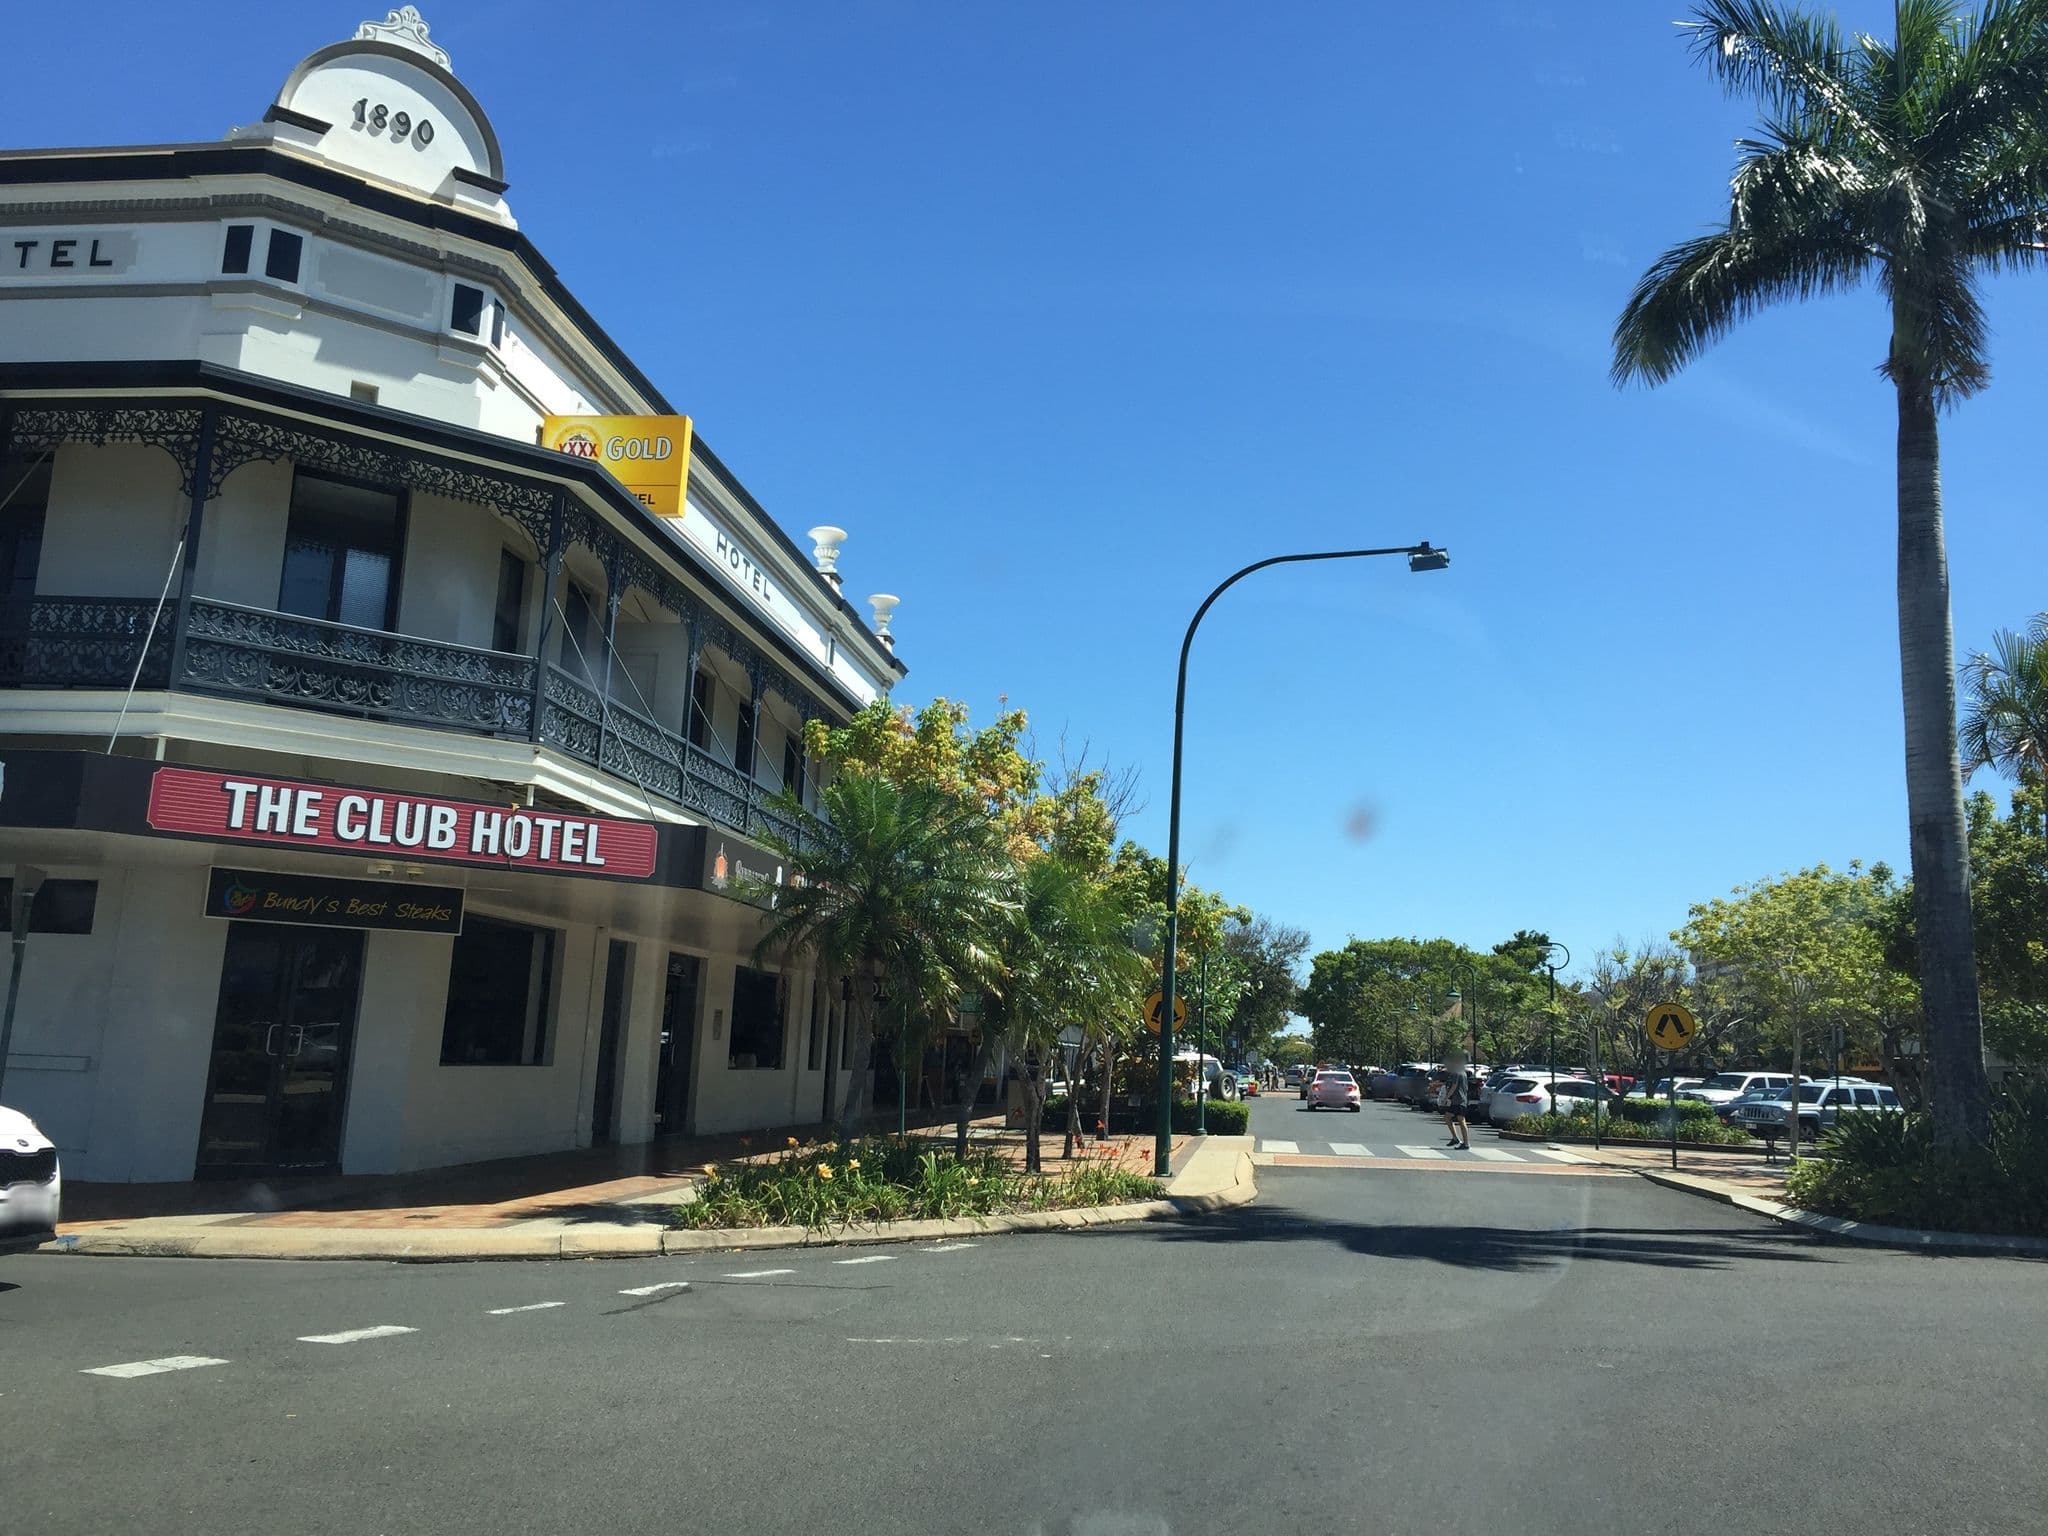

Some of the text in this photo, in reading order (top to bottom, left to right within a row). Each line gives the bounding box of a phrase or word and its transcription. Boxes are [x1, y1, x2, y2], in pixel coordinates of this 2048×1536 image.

[352, 97, 435, 145] 1890
[558, 435, 673, 462] XXXX GOLD
[633, 493, 656, 505] EL
[716, 530, 771, 602] HOTEL
[224, 779, 606, 866] THE CLUB HOTEL
[263, 891, 453, 922] Bundy's Best Steaks
